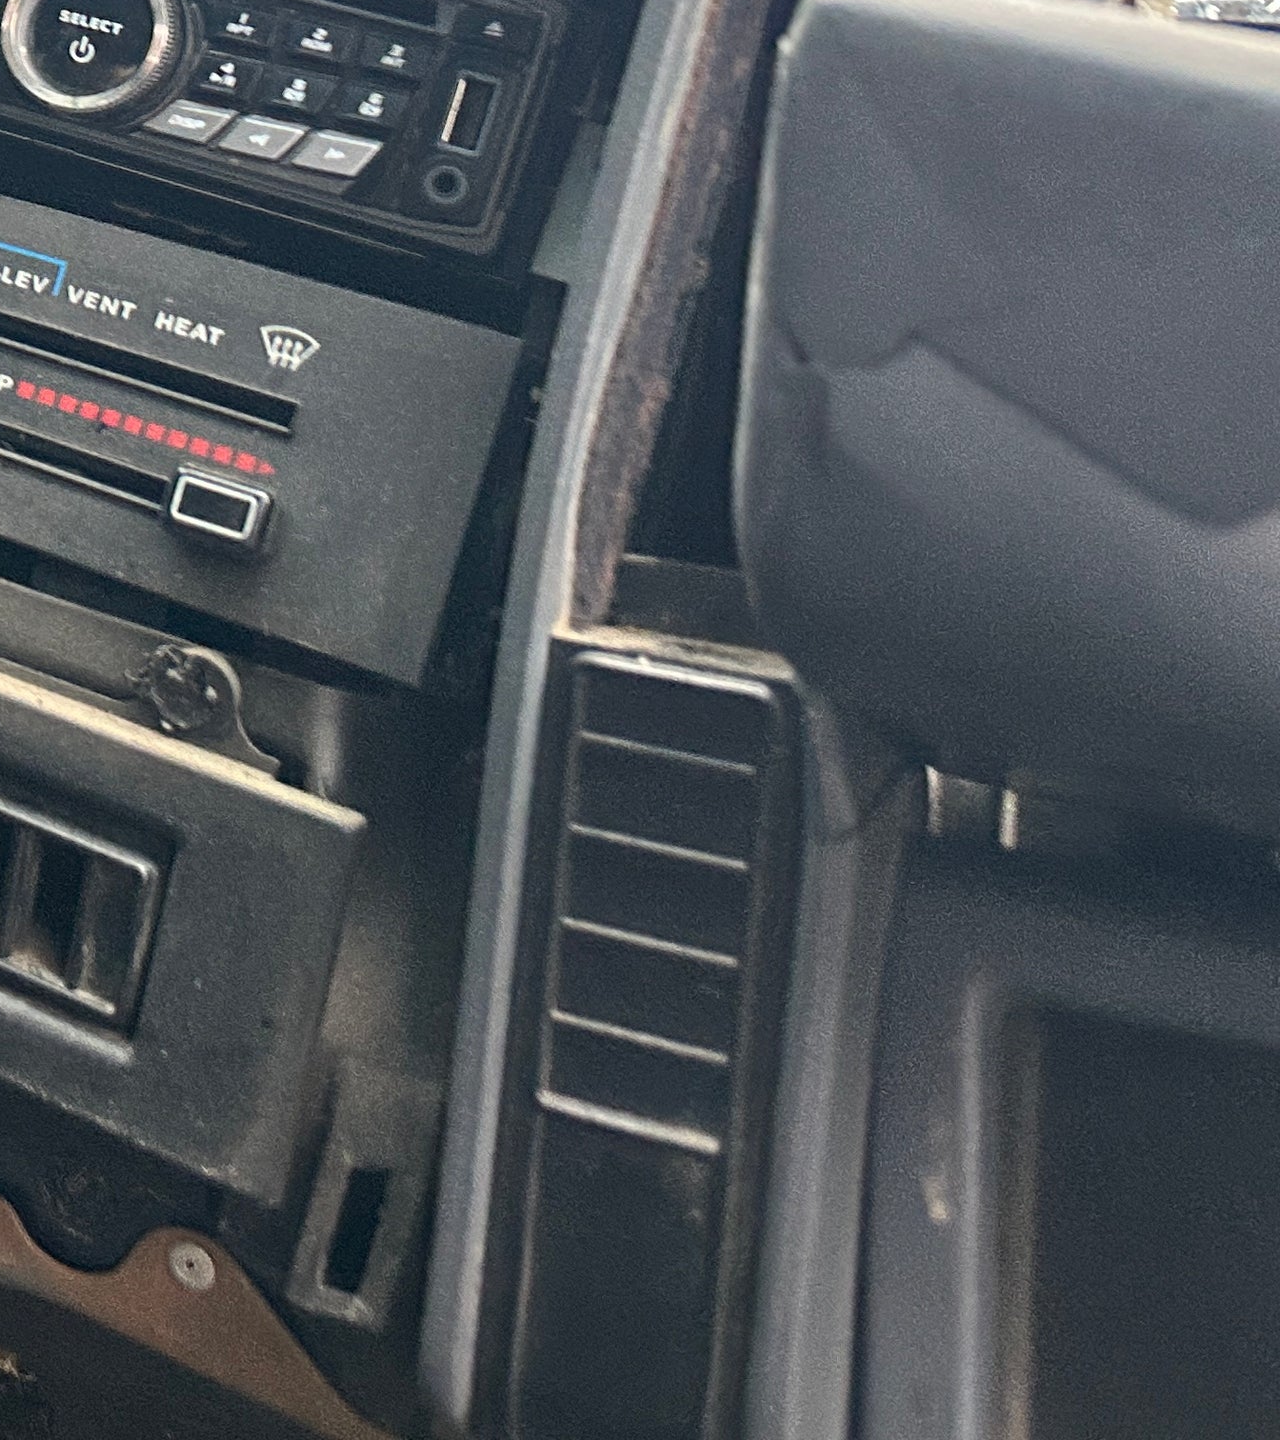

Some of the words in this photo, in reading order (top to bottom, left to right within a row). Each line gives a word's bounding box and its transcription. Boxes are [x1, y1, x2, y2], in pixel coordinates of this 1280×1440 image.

[59, 9, 124, 36] SELECT
[67, 285, 138, 321] VENT
[154, 310, 226, 347] HEAT
